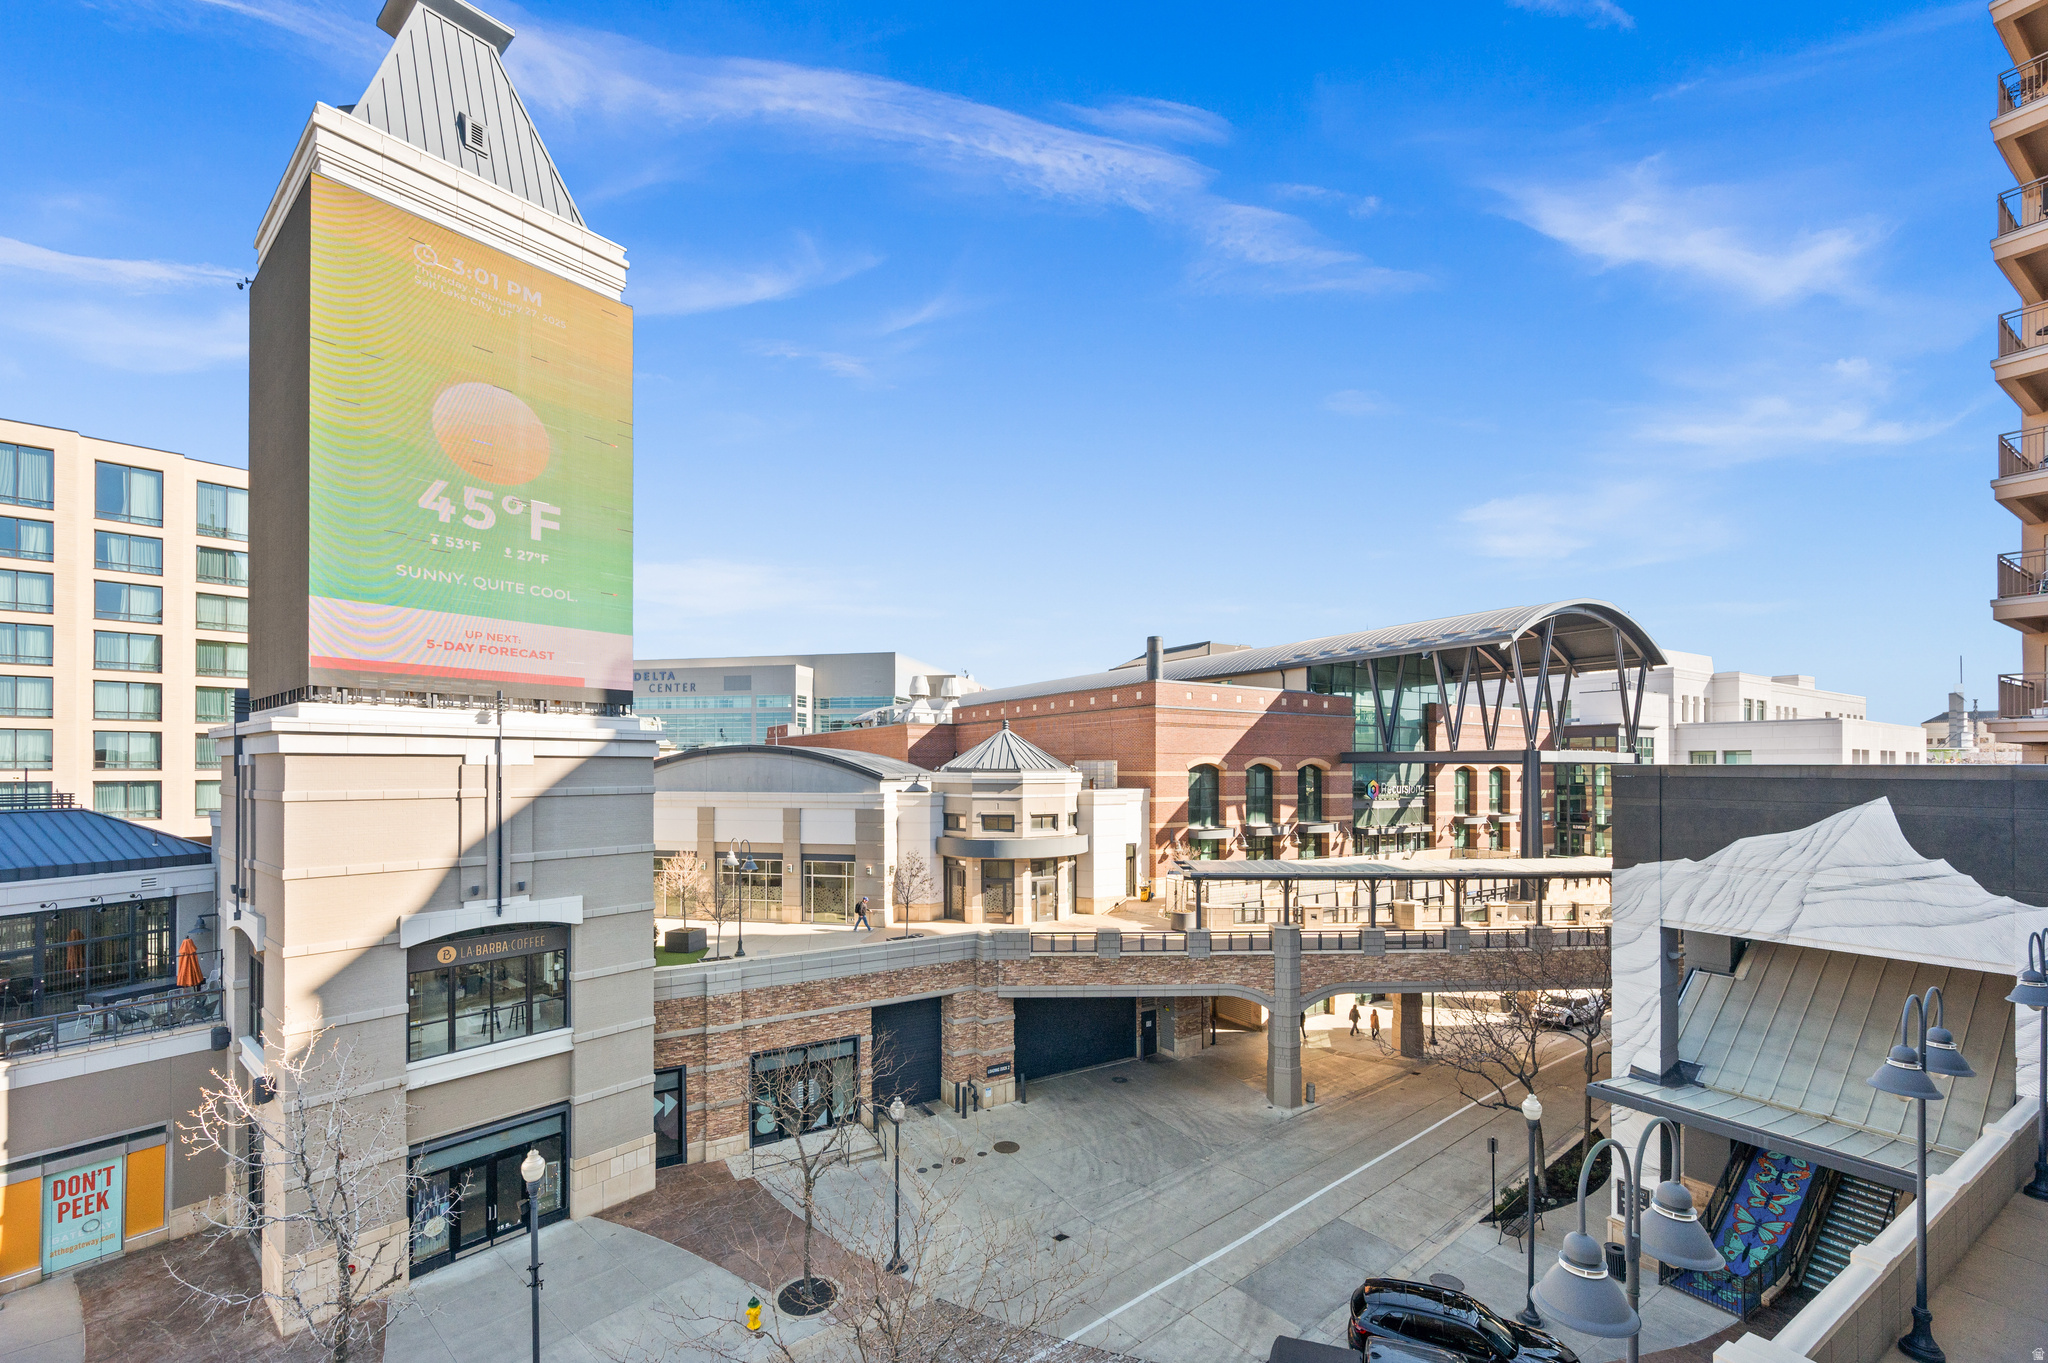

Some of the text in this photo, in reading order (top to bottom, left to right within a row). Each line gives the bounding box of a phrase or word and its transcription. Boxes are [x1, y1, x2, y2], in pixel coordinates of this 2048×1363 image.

[414, 275, 437, 291] Salt
[441, 285, 467, 302] Lake
[498, 307, 513, 319] UT
[452, 257, 542, 307] 3:01 PM
[475, 287, 522, 313] February
[543, 314, 567, 329] 2025
[418, 479, 561, 541] 45°F
[396, 564, 578, 602] SUNNY. QUITE COOL.
[426, 639, 555, 661] 5-DAY FORECAST
[465, 630, 522, 644] UP NEXT:
[633, 671, 676, 681] DELTA
[649, 682, 696, 693] CENTER
[1381, 782, 1421, 794] Recursion
[53, 1165, 115, 1202] DON'T
[57, 1189, 109, 1224] PEEK
[49, 1233, 116, 1258] atthegateway.com
